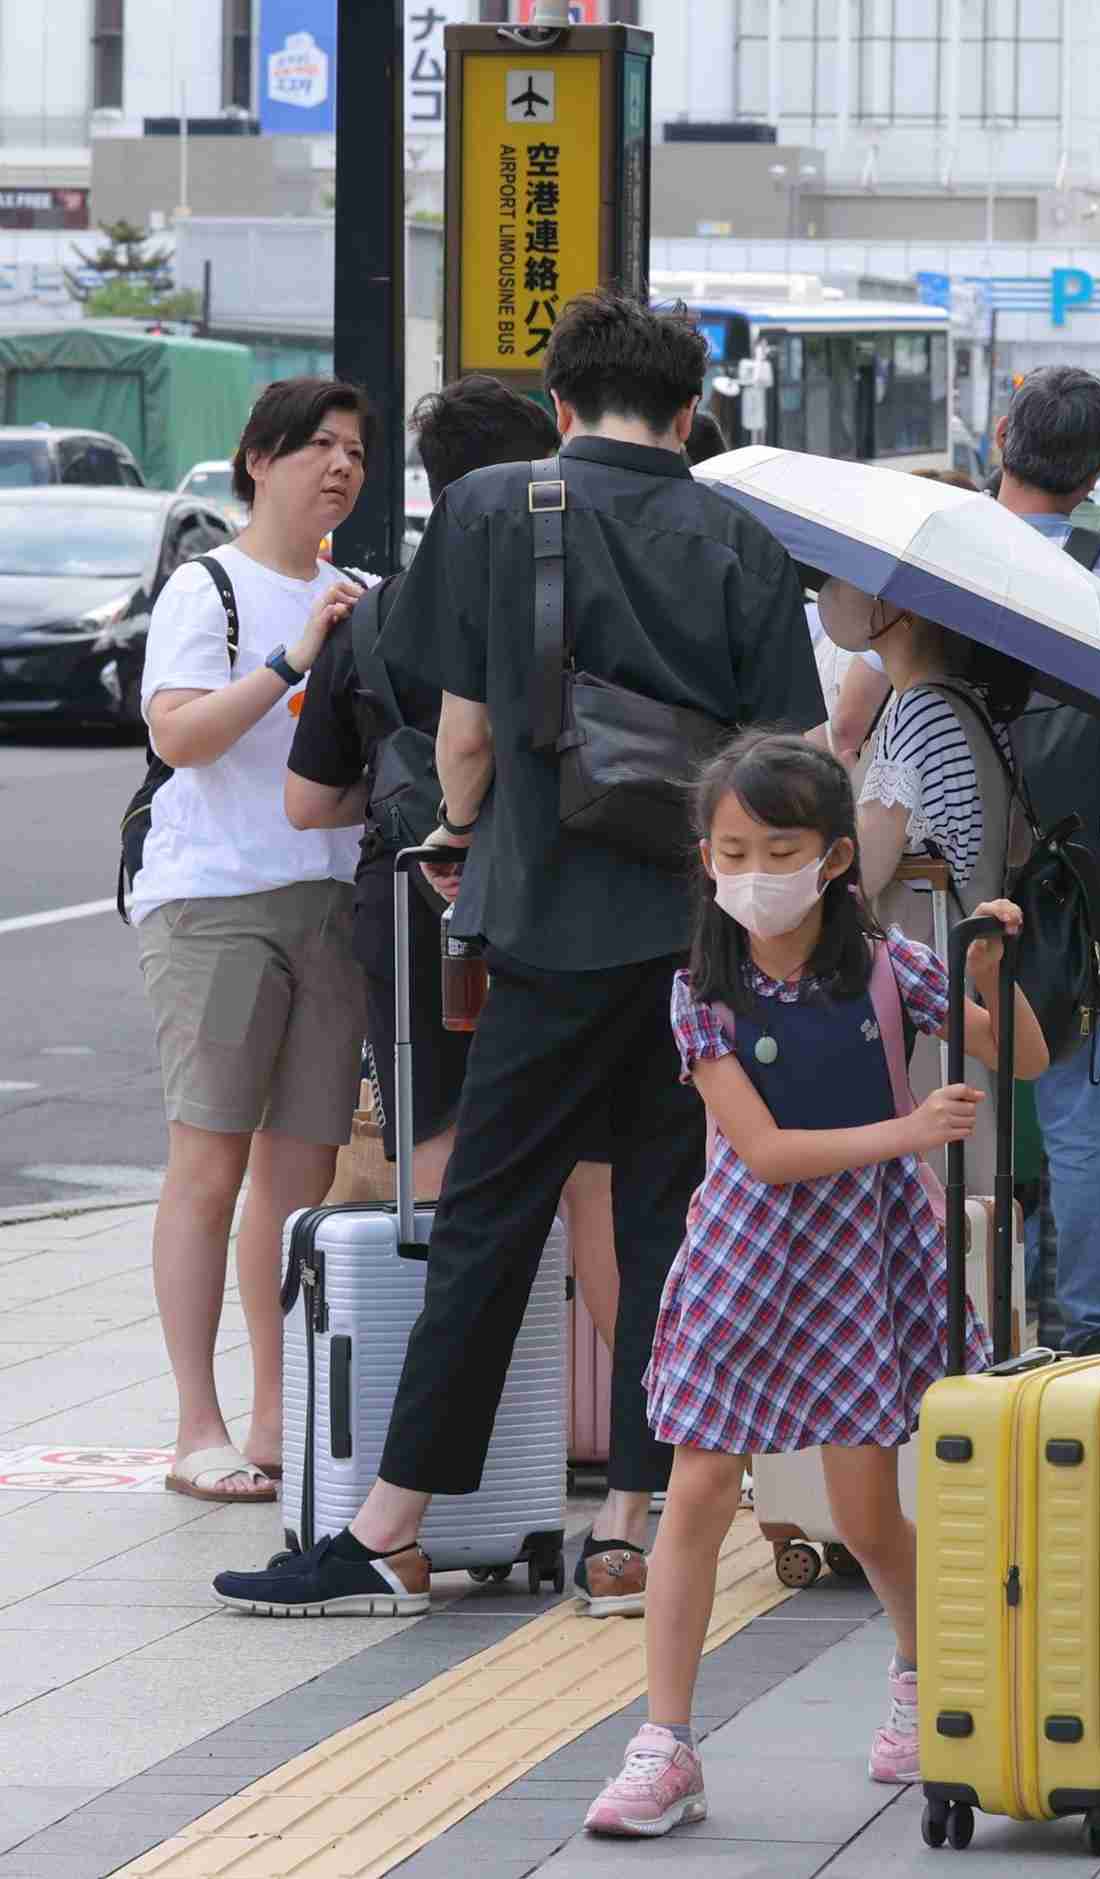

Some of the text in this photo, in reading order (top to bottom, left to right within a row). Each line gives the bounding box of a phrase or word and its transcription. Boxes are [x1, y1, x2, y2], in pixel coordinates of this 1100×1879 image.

[410, 7, 446, 122] ナムコ
[497, 144, 518, 356] AIRPORT LIMOUSINE BUS
[523, 142, 560, 358] 空港連絡バス
[1051, 267, 1094, 326] P
